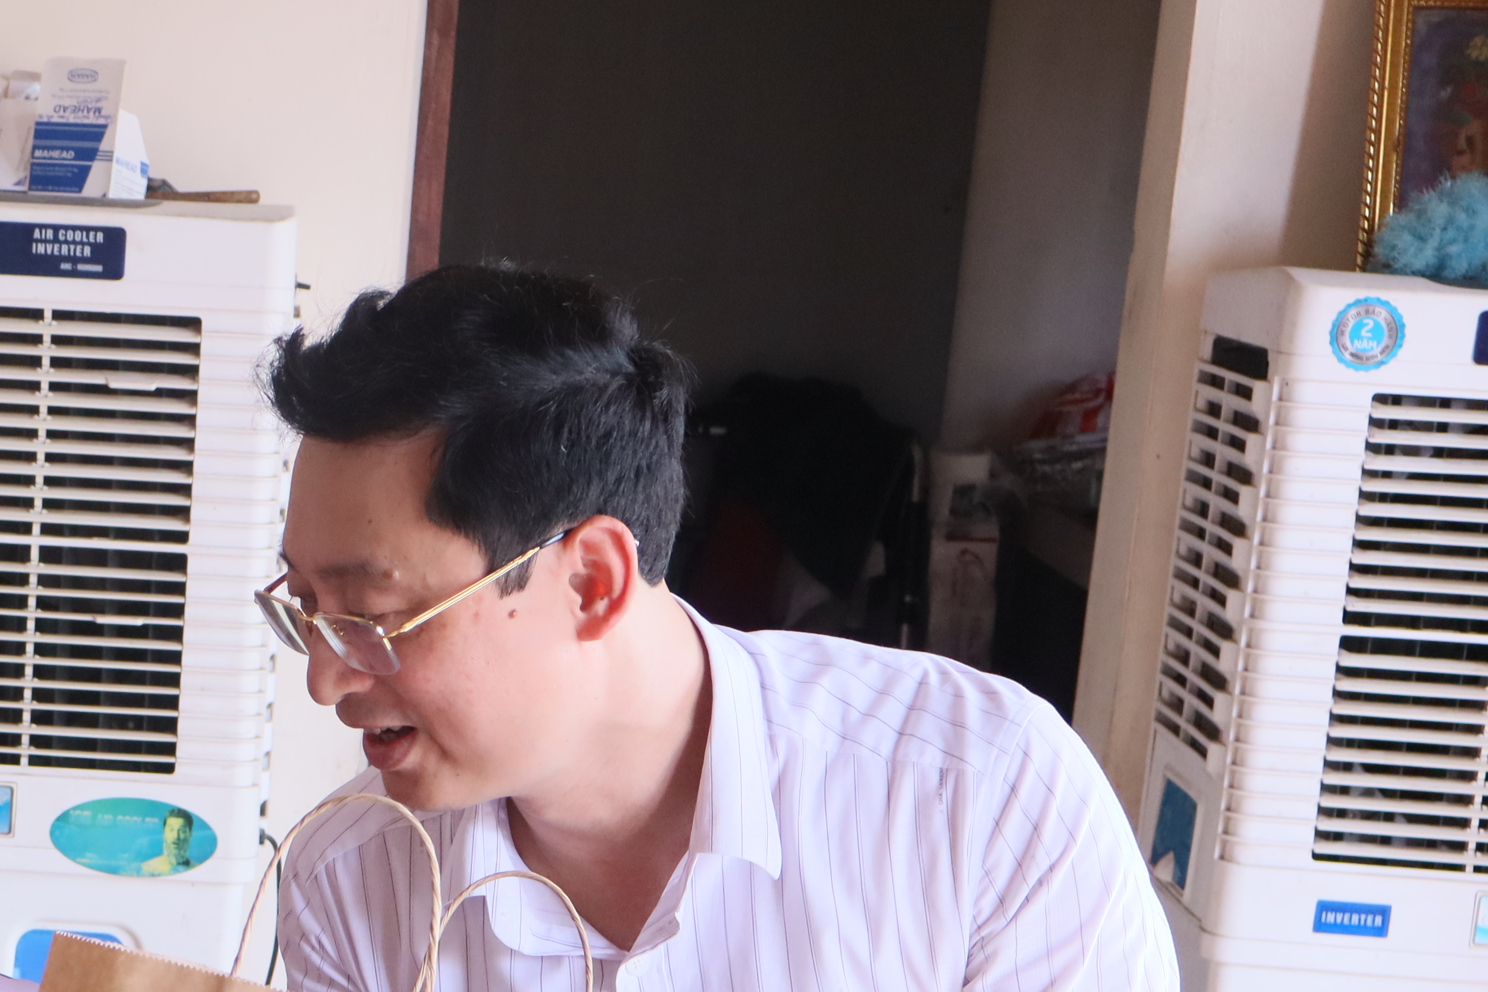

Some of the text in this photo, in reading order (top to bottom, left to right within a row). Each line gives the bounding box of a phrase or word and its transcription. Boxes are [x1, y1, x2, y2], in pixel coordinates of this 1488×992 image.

[53, 104, 104, 116] MAHEAD
[33, 149, 75, 160] MAHEAD
[33, 228, 104, 243] AIR COOLER
[32, 242, 91, 257] INVERTER
[1360, 318, 1374, 338] 2
[1353, 337, 1377, 350] NĂM
[1320, 910, 1383, 927] INVERTER
